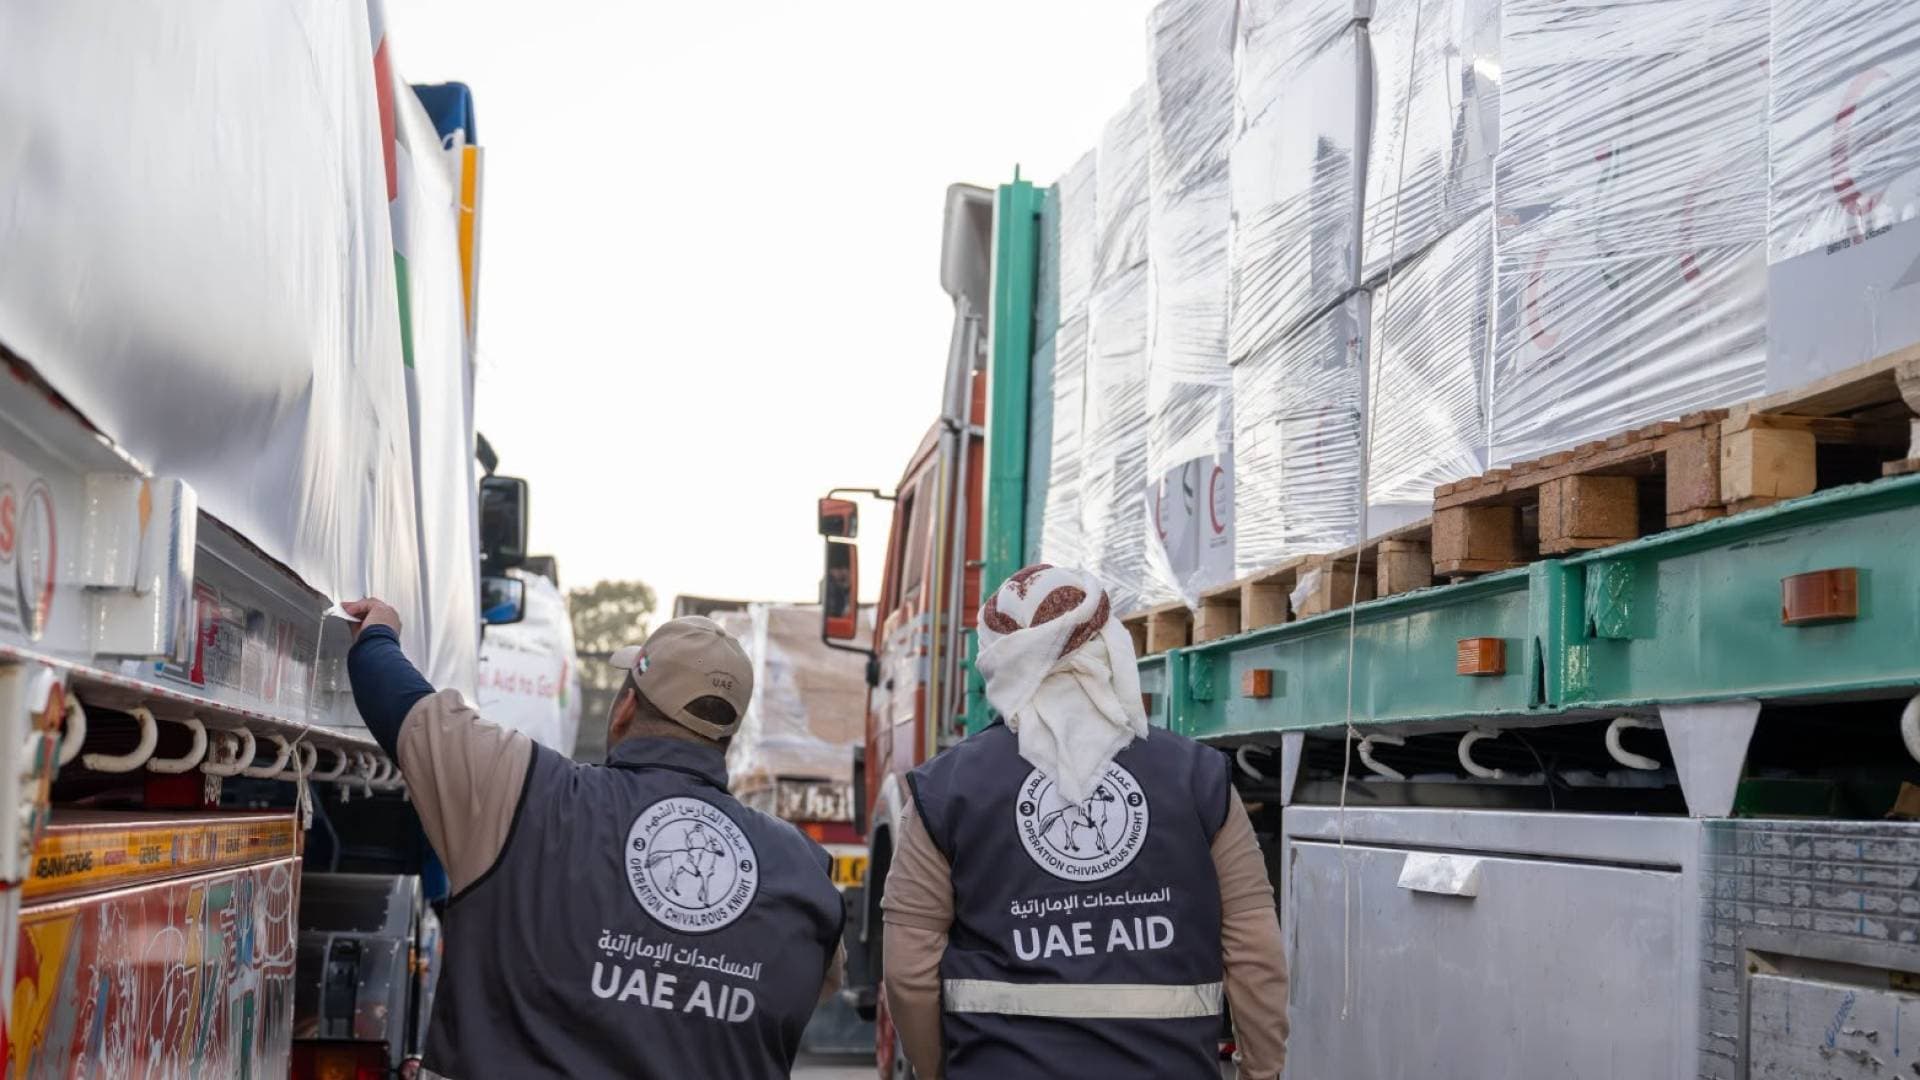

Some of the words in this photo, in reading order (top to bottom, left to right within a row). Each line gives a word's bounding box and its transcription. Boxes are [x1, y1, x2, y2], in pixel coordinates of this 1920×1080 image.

[711, 677, 734, 691] UAE
[1023, 819, 1065, 871] OPERATION
[1065, 848, 1130, 876] CHIVALROUS
[1126, 810, 1143, 851] KNIGHT
[630, 857, 664, 913] OPERATION
[664, 907, 728, 927] CHIVALROUS
[726, 878, 753, 913] KNIGHT
[1010, 894, 1079, 919] الإماراتية
[1082, 886, 1170, 908] المساعدات
[597, 928, 673, 968] الإماراتية
[1012, 920, 1096, 962] UAE
[1106, 915, 1175, 953] AID
[673, 947, 763, 982] المساعدات
[591, 961, 678, 1010] UAE
[682, 979, 756, 1023] AID
